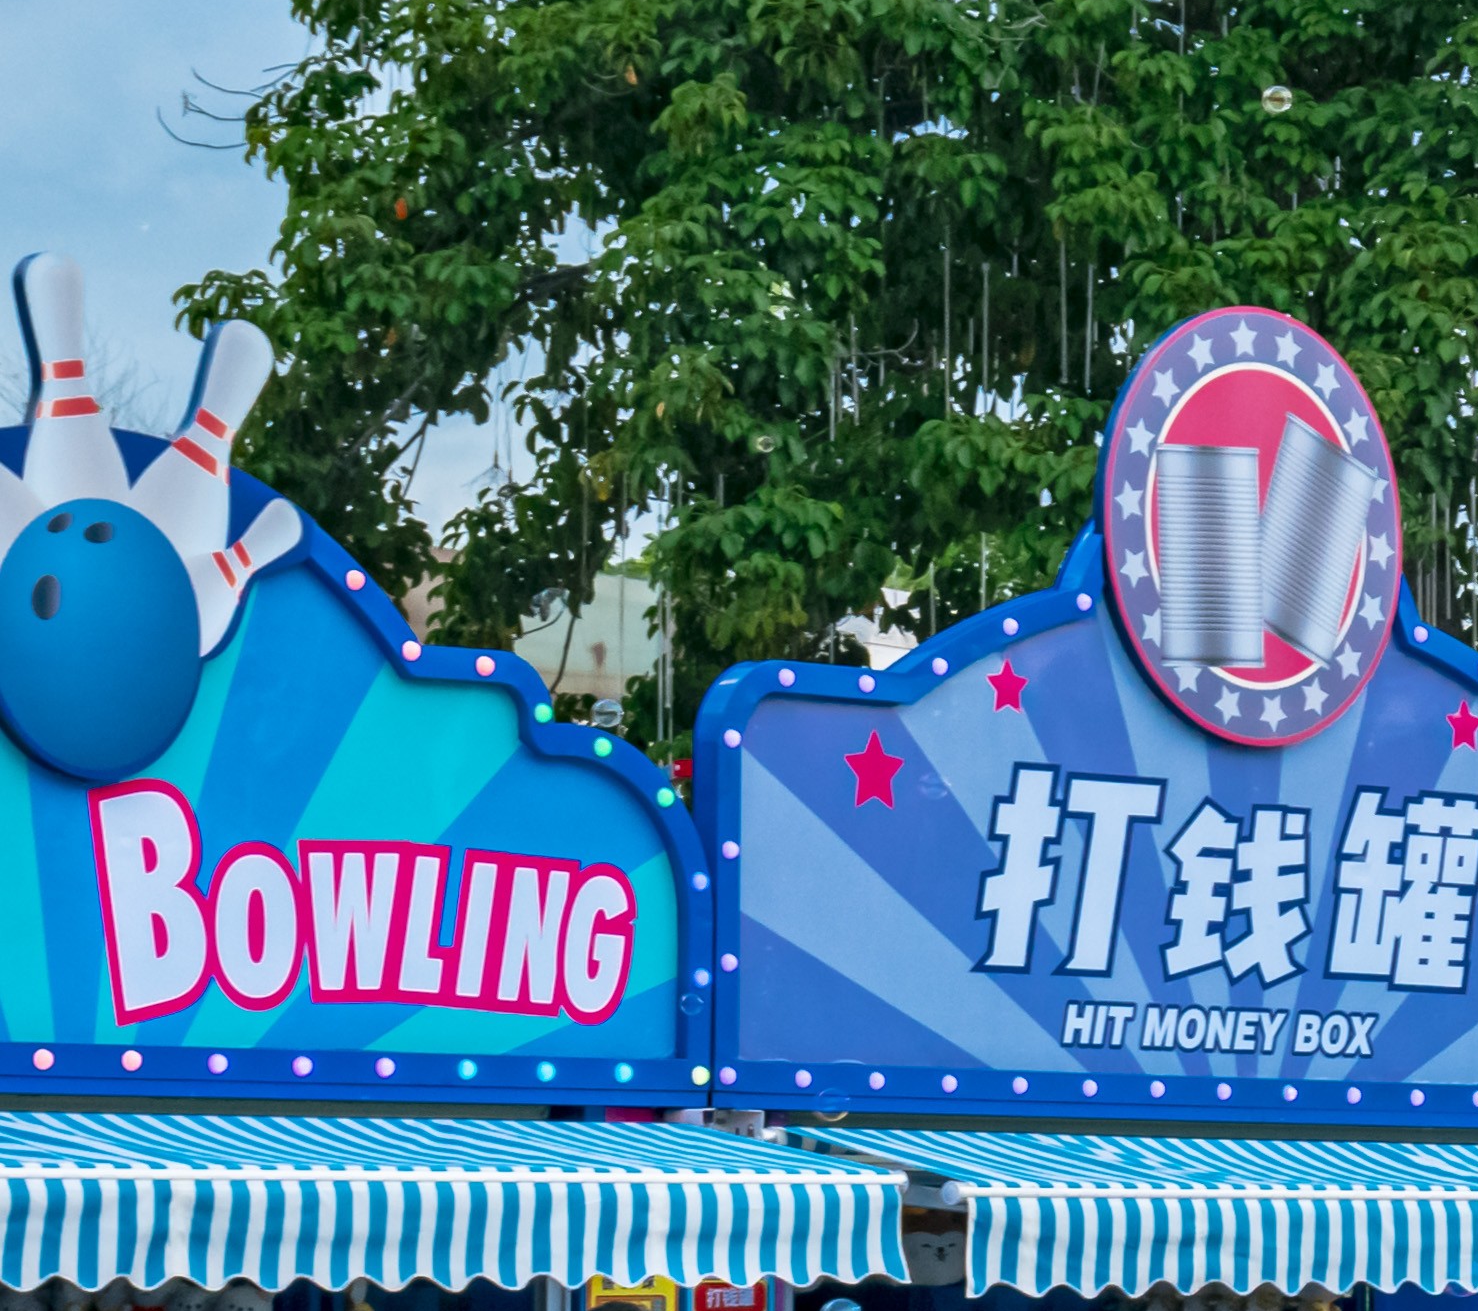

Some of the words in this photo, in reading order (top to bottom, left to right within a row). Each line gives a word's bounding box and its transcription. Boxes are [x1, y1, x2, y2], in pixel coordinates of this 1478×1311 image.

[90, 782, 635, 1023] BOWLING
[1062, 1002, 1134, 1047] HIT
[1141, 1005, 1288, 1053] MONEY
[1294, 1013, 1378, 1056] BOX
